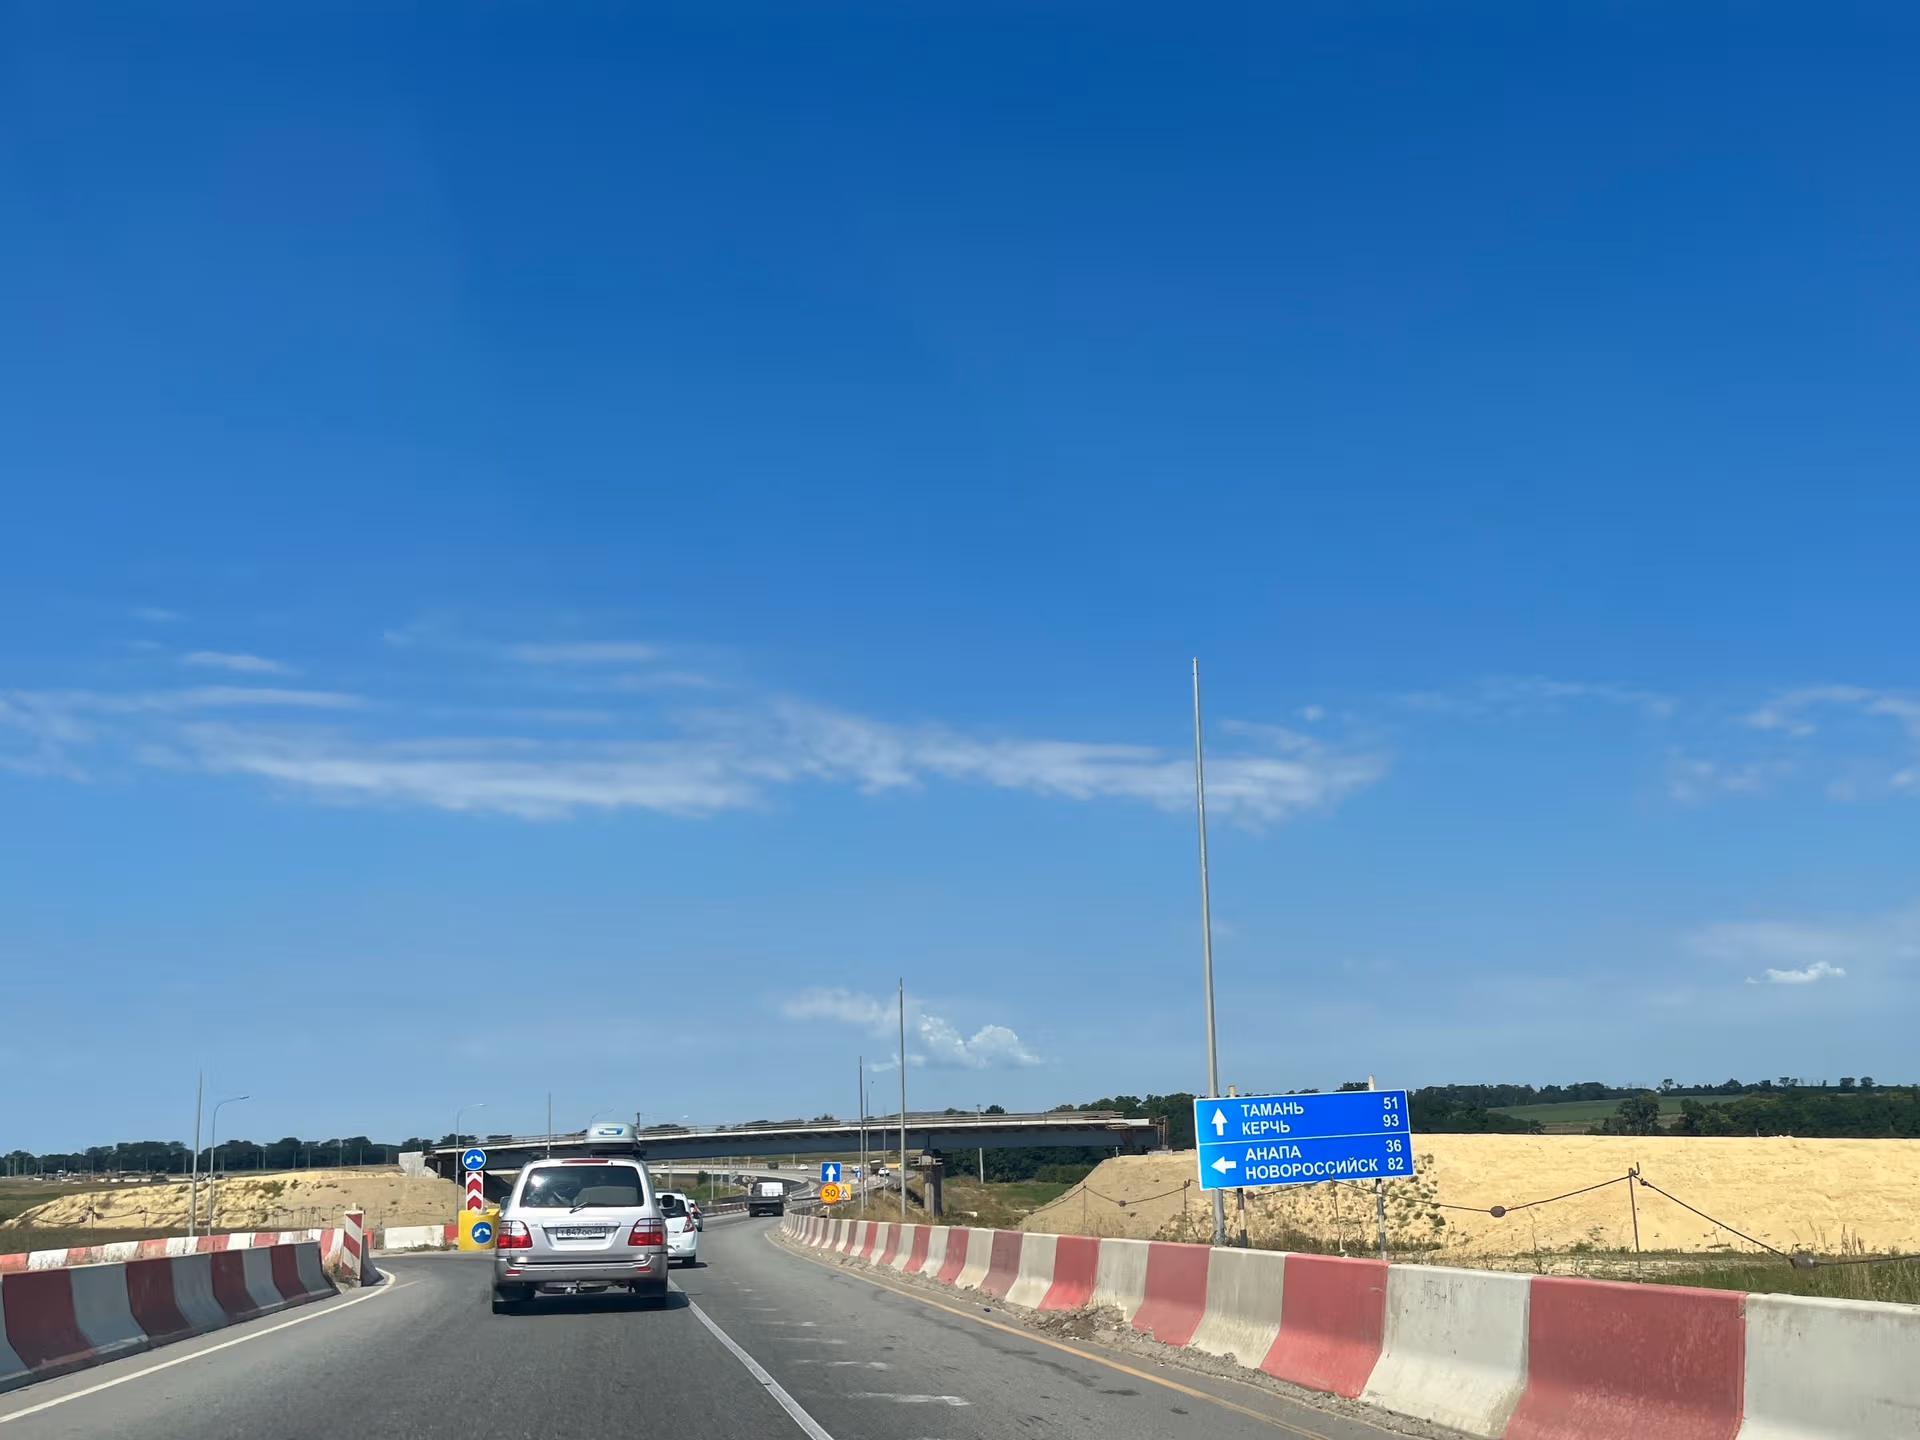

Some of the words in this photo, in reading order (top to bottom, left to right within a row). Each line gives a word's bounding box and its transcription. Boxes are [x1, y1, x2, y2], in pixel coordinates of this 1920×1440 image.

[1240, 1102, 1304, 1118] ТАМАНЬ
[1383, 1096, 1399, 1110] 51
[1241, 1120, 1291, 1136] КЕРЧЬ
[1382, 1113, 1400, 1128] 93
[1245, 1145, 1302, 1161] АНАПА
[1385, 1139, 1402, 1153] 36
[1245, 1157, 1379, 1180] НОВОРОССИЙСК
[1387, 1157, 1404, 1171] 82
[825, 1189, 836, 1197] 50
